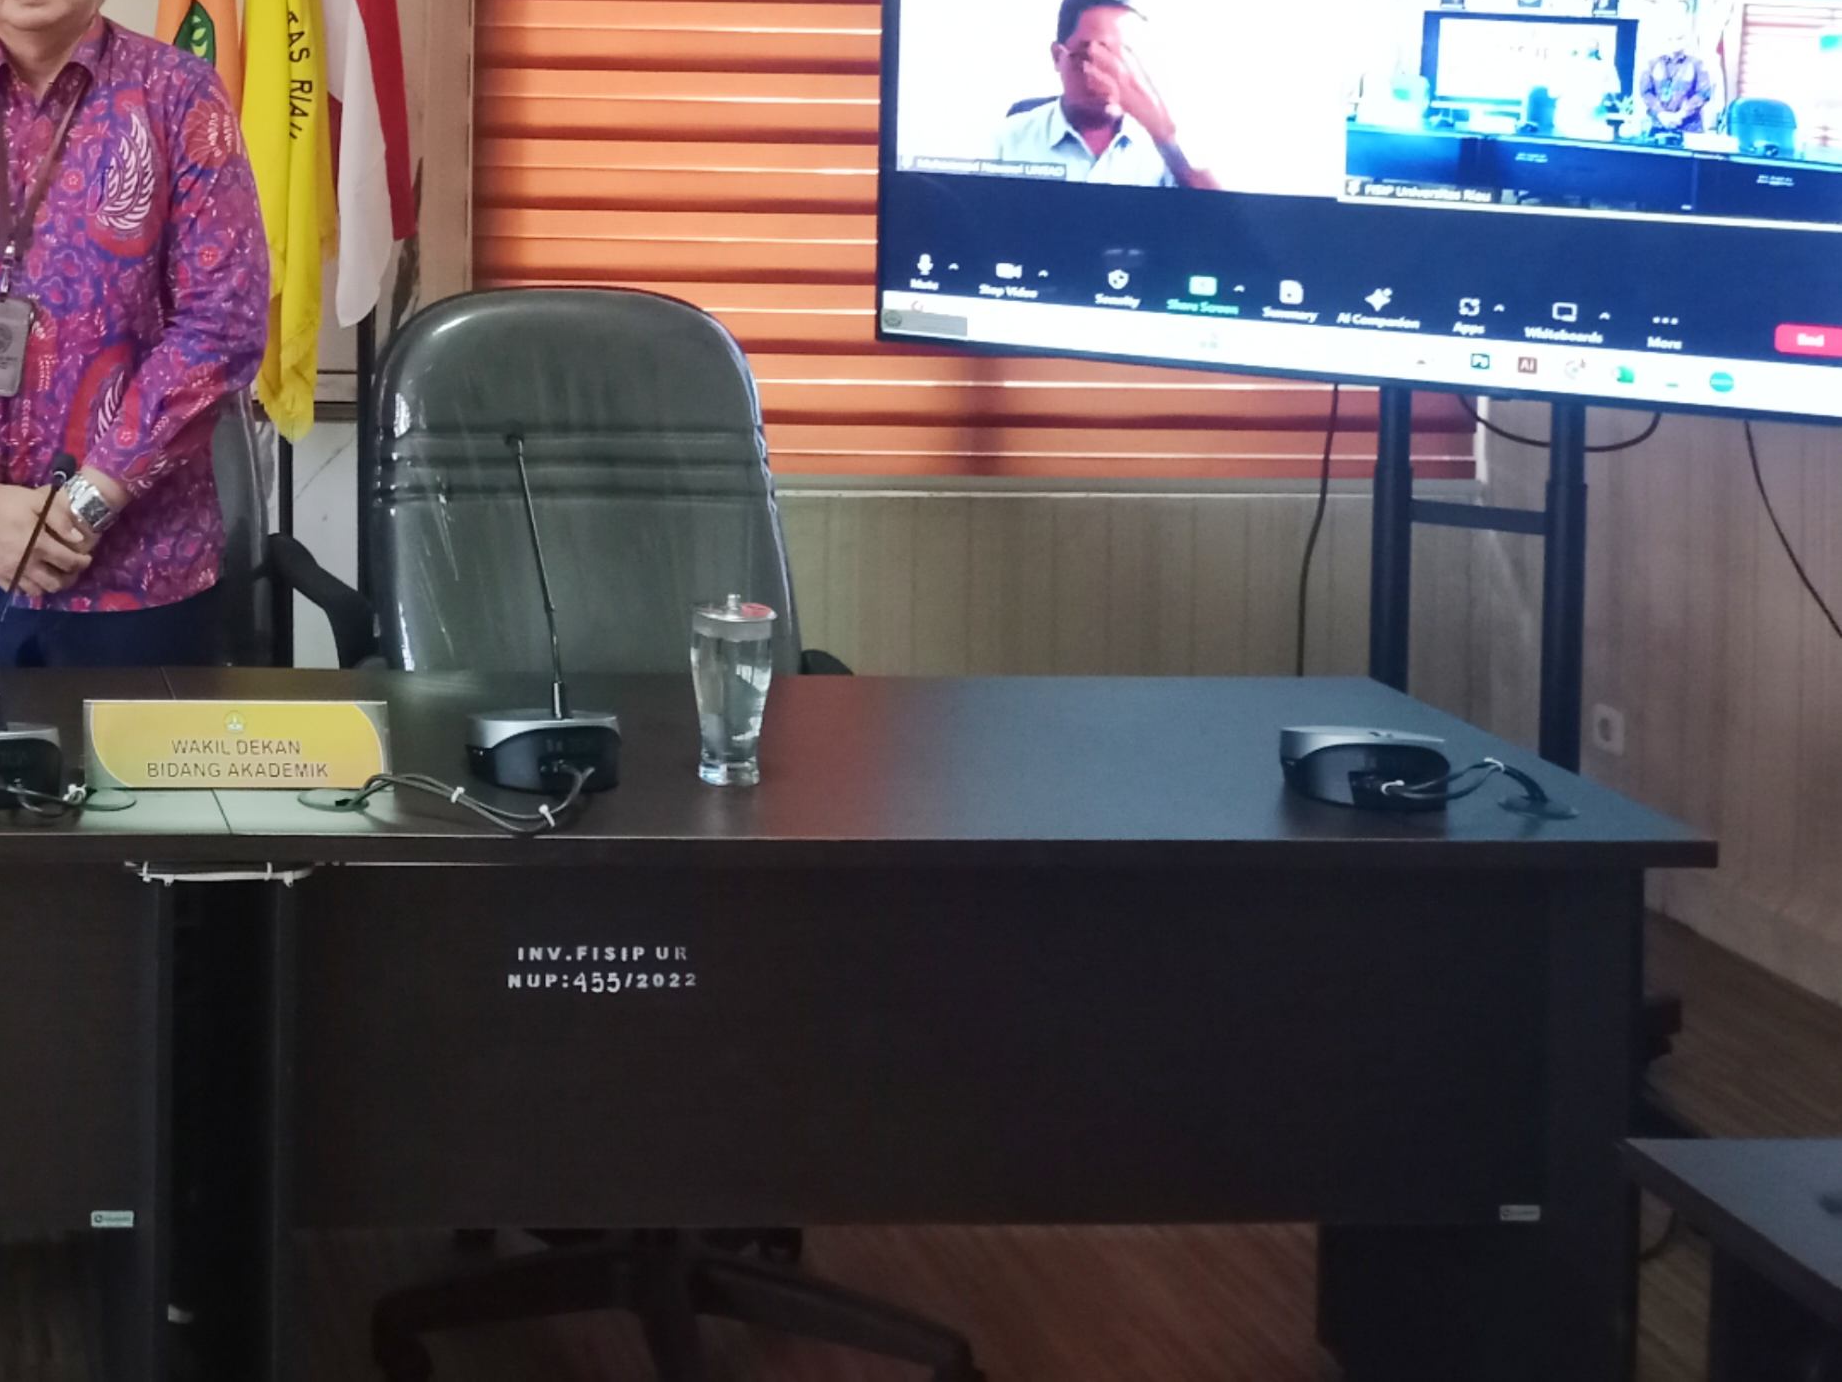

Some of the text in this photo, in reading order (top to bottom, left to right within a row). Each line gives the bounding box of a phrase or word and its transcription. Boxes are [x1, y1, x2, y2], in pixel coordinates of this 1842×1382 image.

[171, 739, 301, 756] WAKIL DEKAN
[147, 762, 329, 778] BIDANG AKADEMIK
[655, 946, 688, 961] UR
